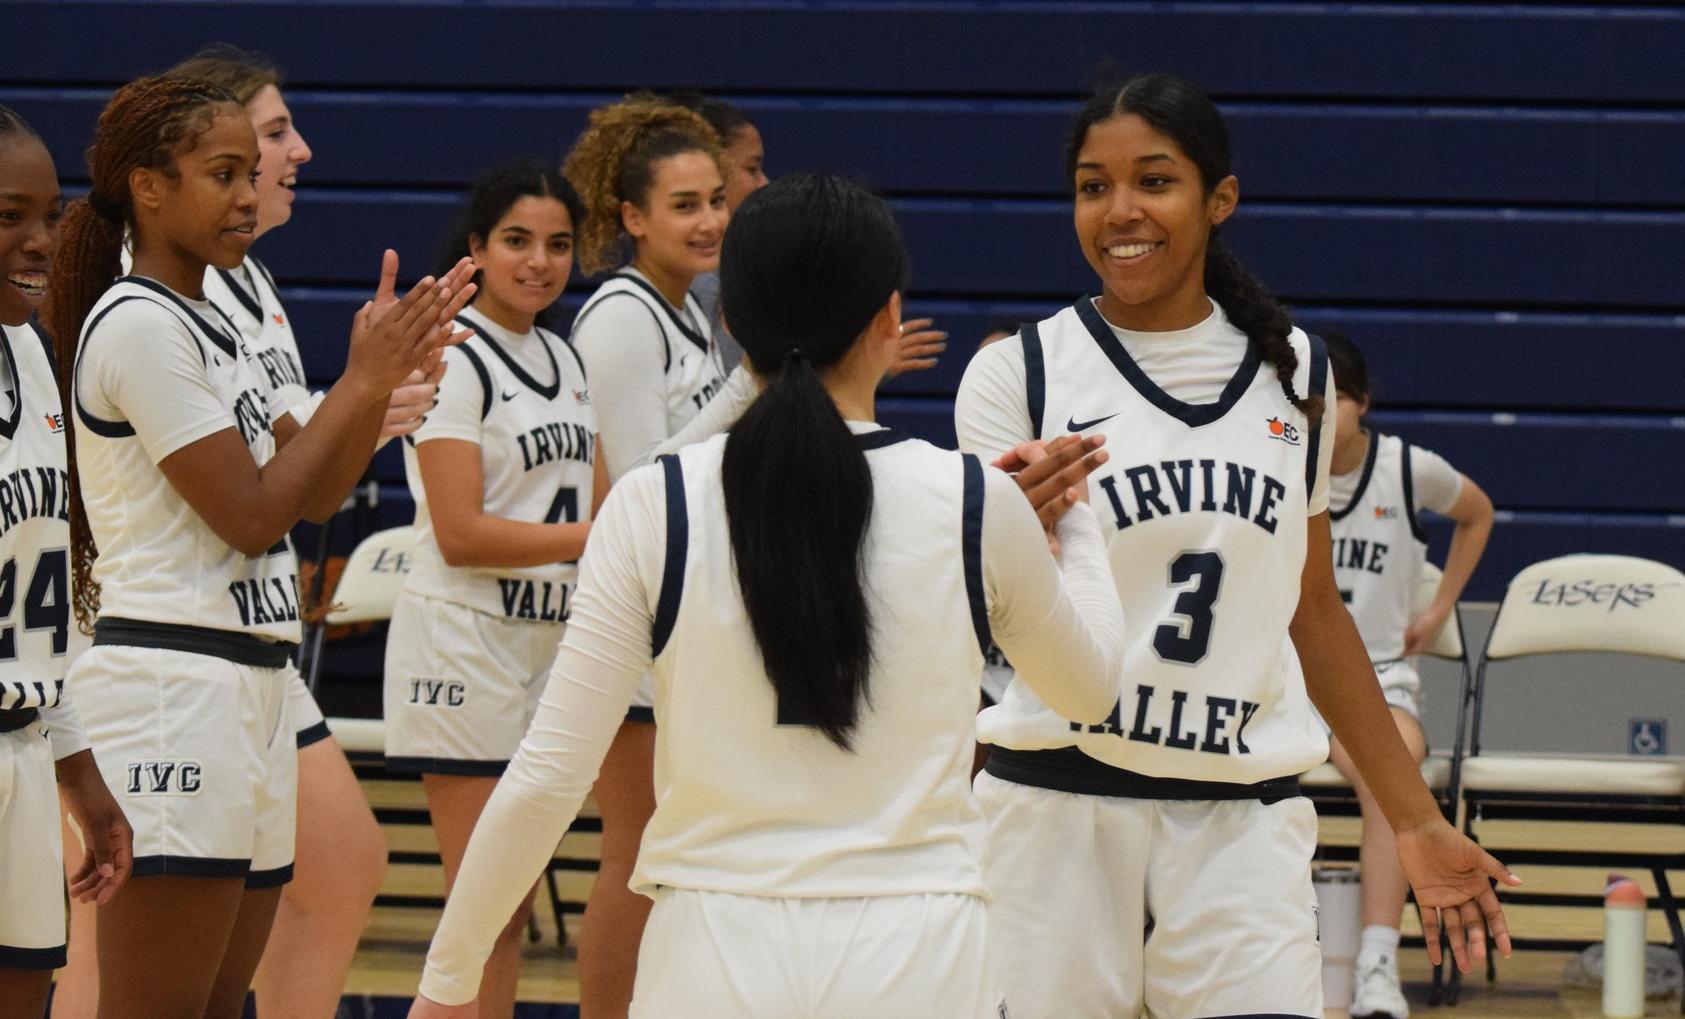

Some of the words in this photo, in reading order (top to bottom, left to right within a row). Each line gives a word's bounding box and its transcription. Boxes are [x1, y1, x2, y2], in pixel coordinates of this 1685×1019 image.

[0, 466, 69, 538] RVINE
[1099, 459, 1286, 535] IRVINE
[1332, 538, 1389, 575] INE
[498, 577, 577, 622] VALL
[1149, 547, 1227, 669] 3
[1533, 577, 1655, 613] LASERS
[409, 678, 465, 707] IVC
[1070, 684, 1260, 755] ALLEY
[127, 761, 202, 793] IVC
